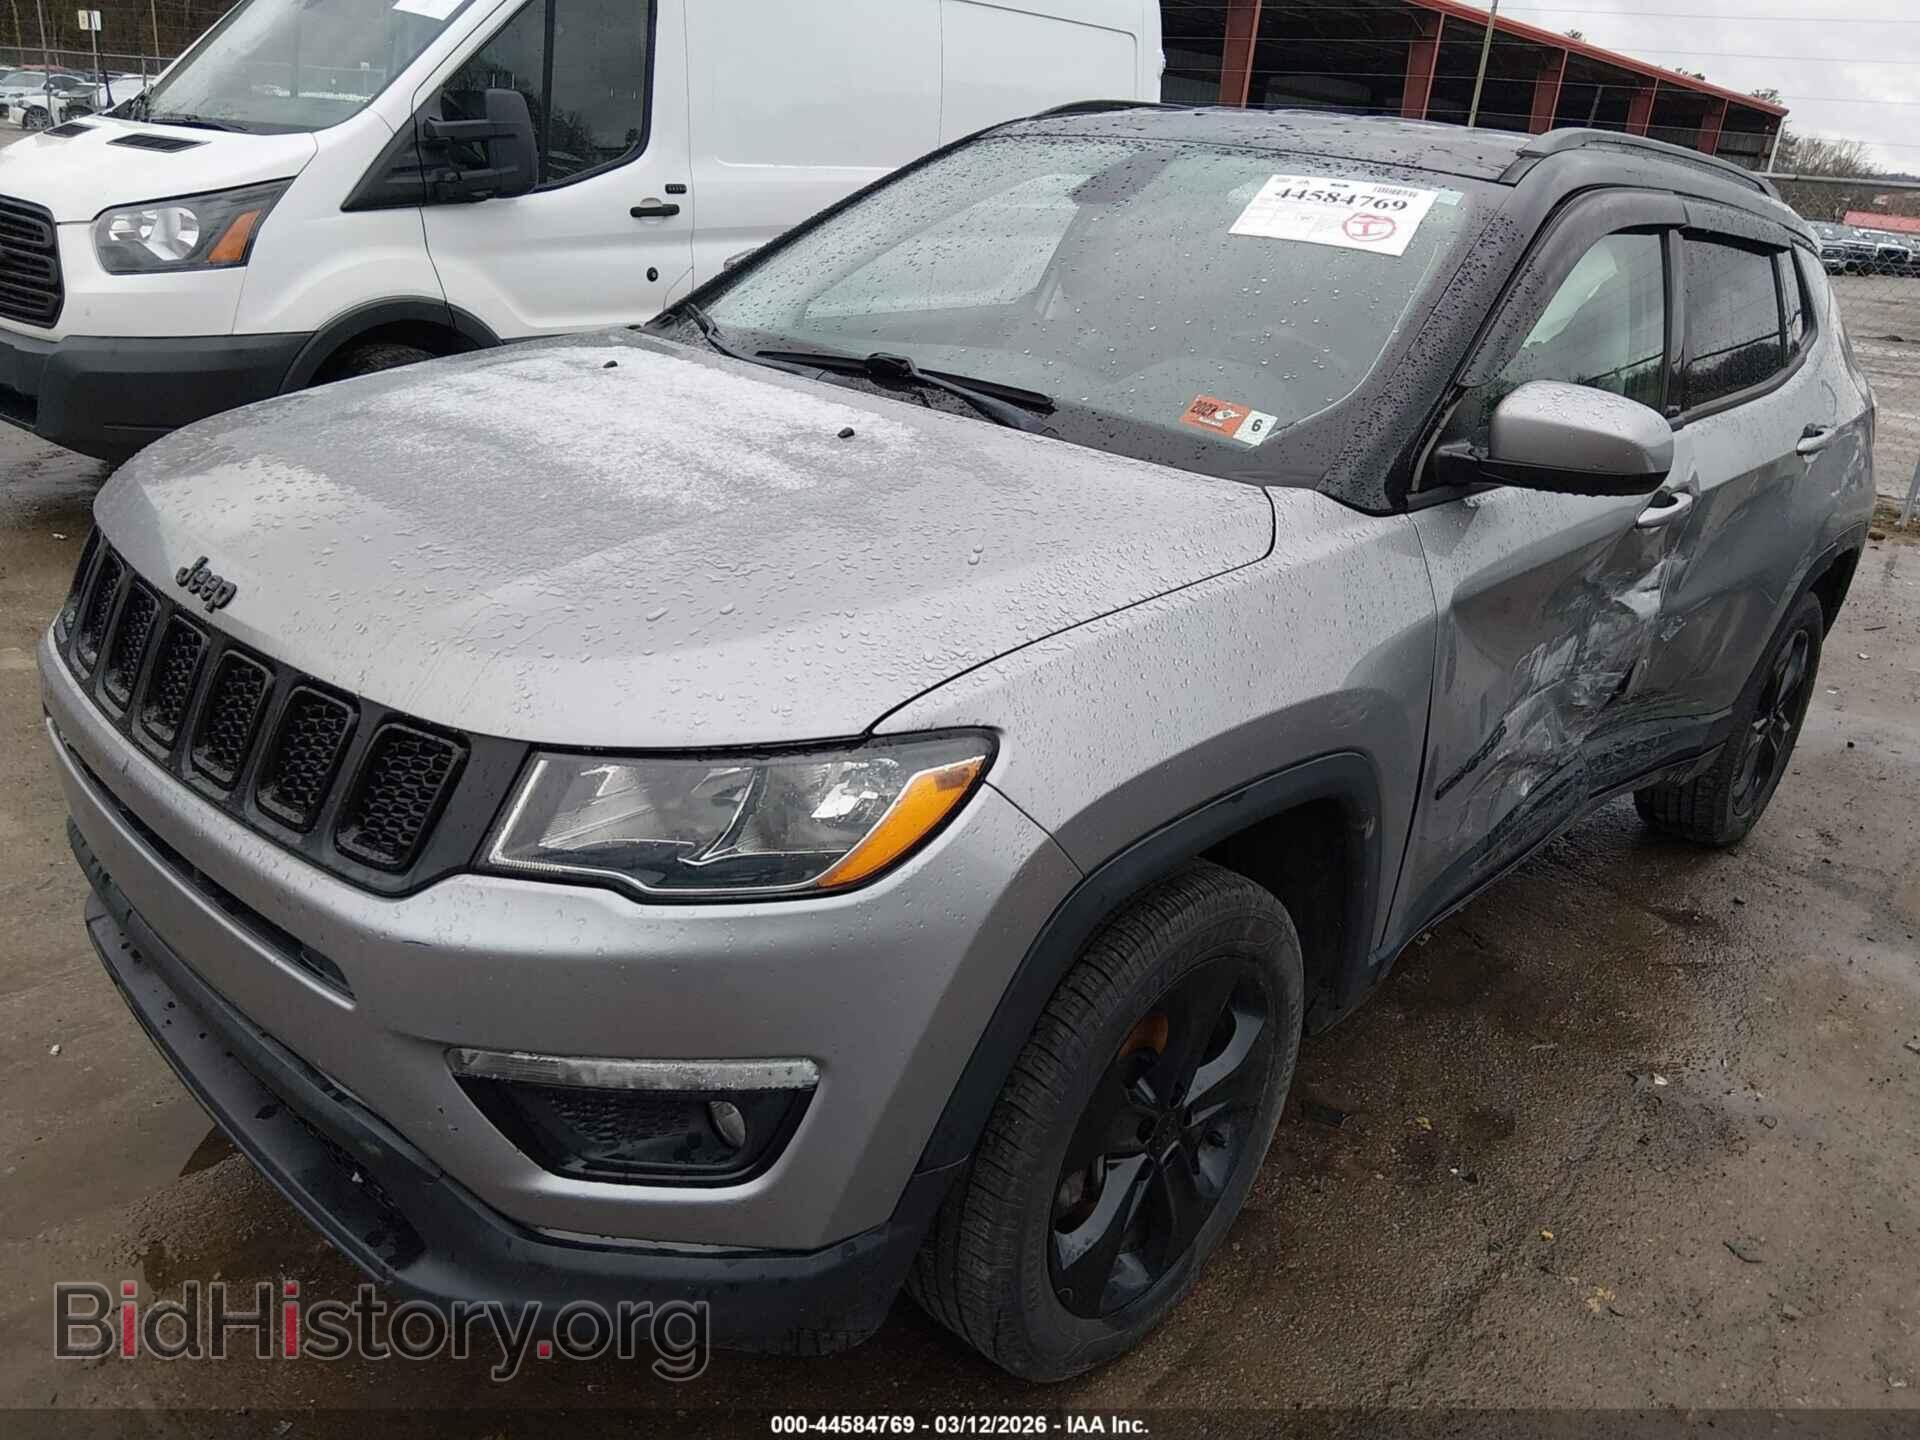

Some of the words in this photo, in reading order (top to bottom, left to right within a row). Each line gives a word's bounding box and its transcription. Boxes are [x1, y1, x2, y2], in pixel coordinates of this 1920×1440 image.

[1274, 187, 1409, 211] 44584769
[1251, 418, 1263, 432] 6
[175, 555, 237, 614] Jeep
